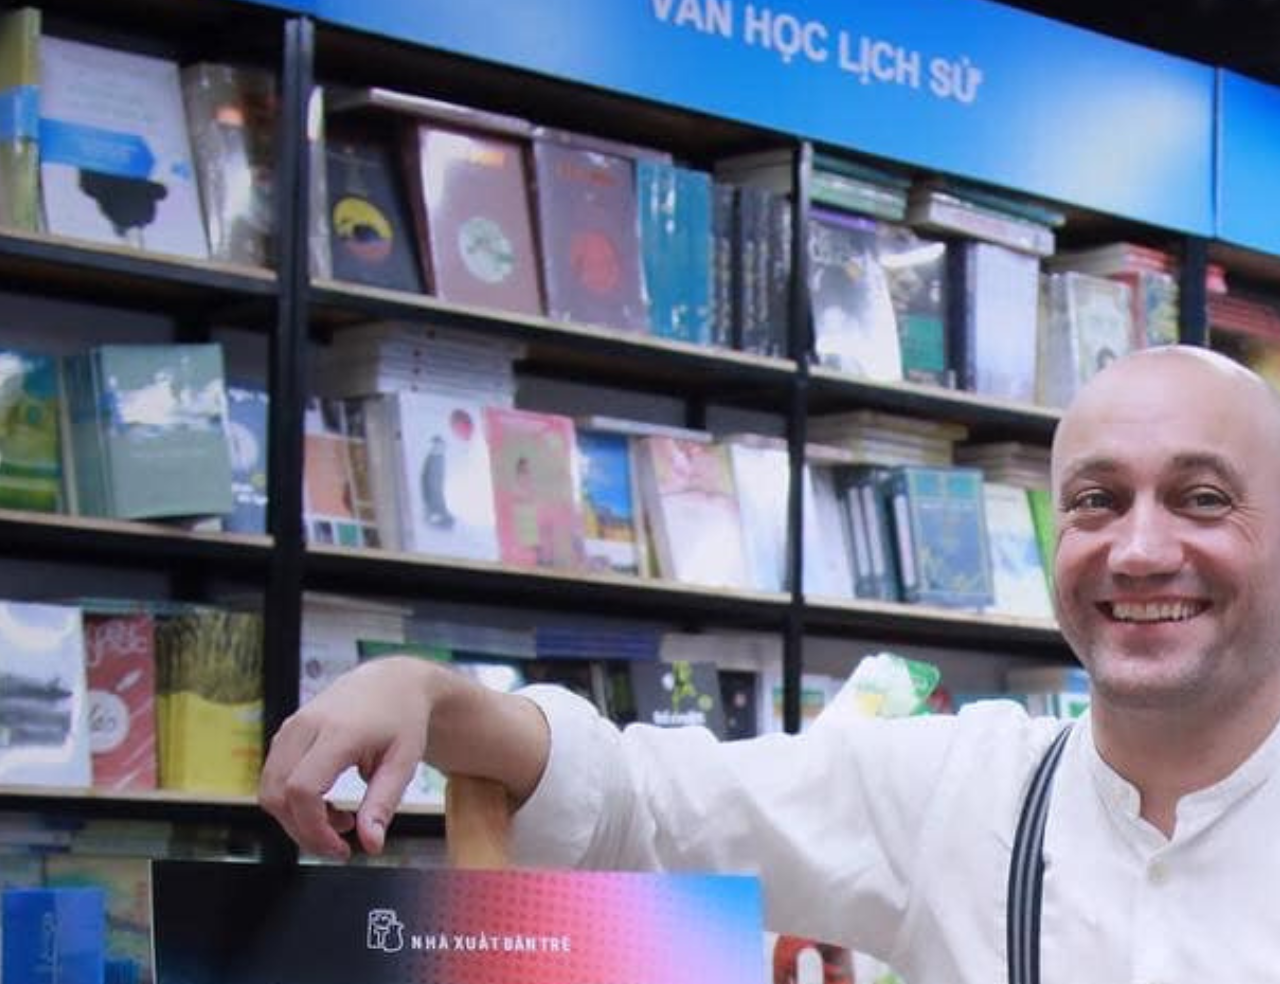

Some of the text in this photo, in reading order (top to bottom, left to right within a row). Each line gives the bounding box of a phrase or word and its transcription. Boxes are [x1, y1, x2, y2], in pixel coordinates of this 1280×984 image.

[744, 6, 829, 64] HỌC
[838, 29, 921, 89] LỊCH
[928, 56, 983, 103] SỬ
